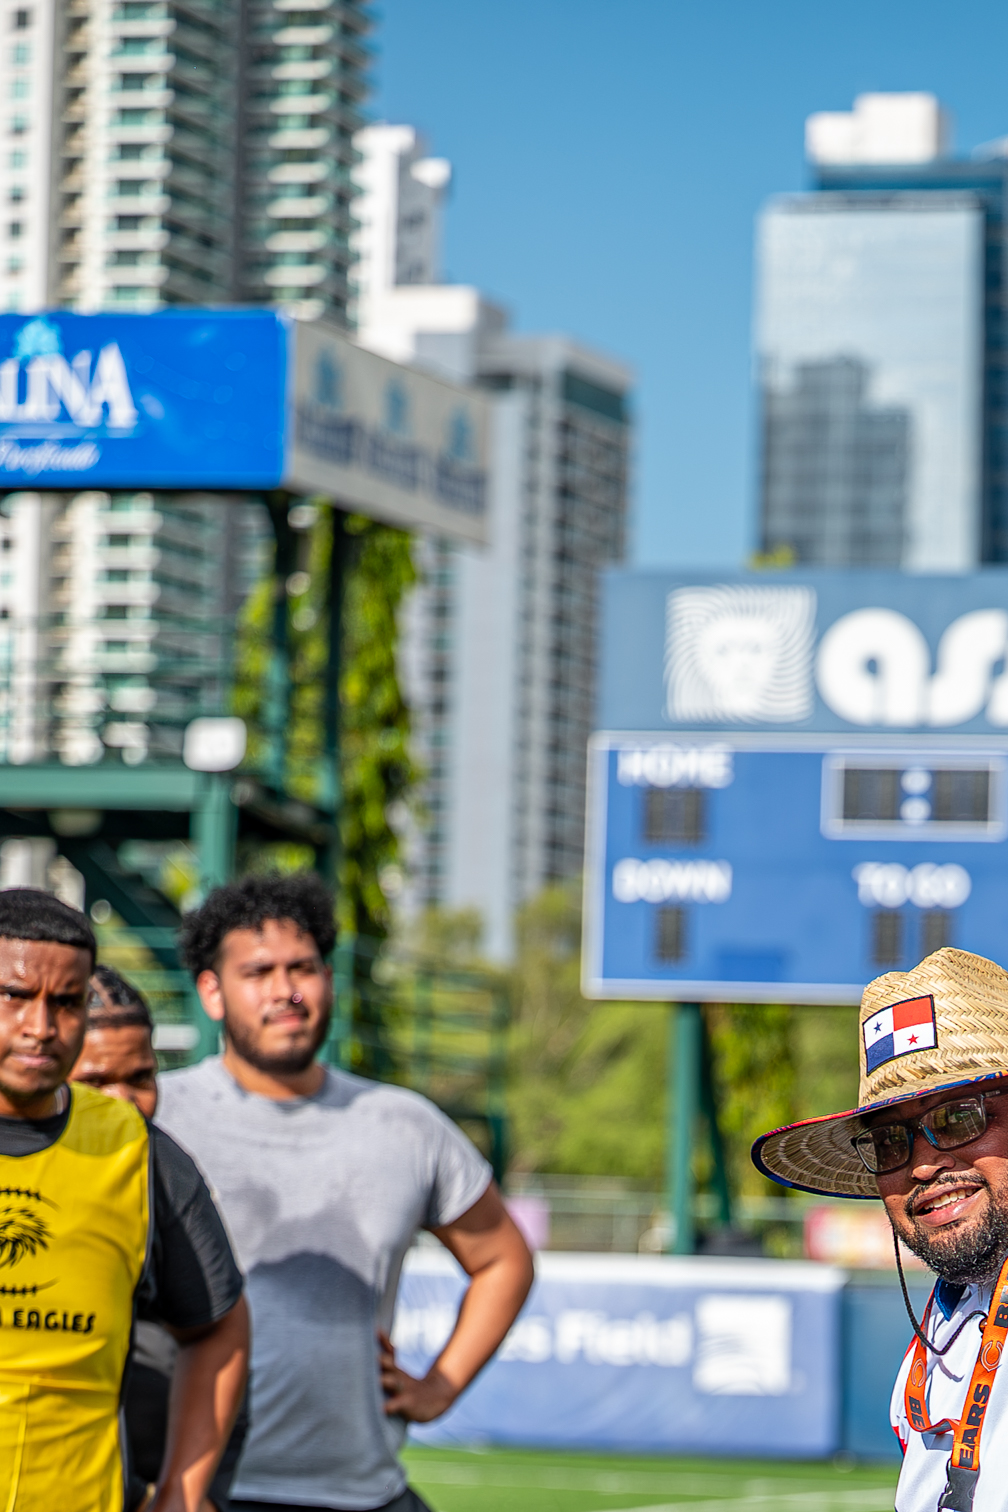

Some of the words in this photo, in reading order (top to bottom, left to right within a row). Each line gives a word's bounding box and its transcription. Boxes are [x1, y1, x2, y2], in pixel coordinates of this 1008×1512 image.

[617, 743, 735, 788] HOME
[612, 857, 733, 904] DOWN
[852, 862, 908, 908] TO
[908, 862, 972, 909] GO
[13, 1310, 96, 1334] EAGLES
[555, 1308, 693, 1367] Field
